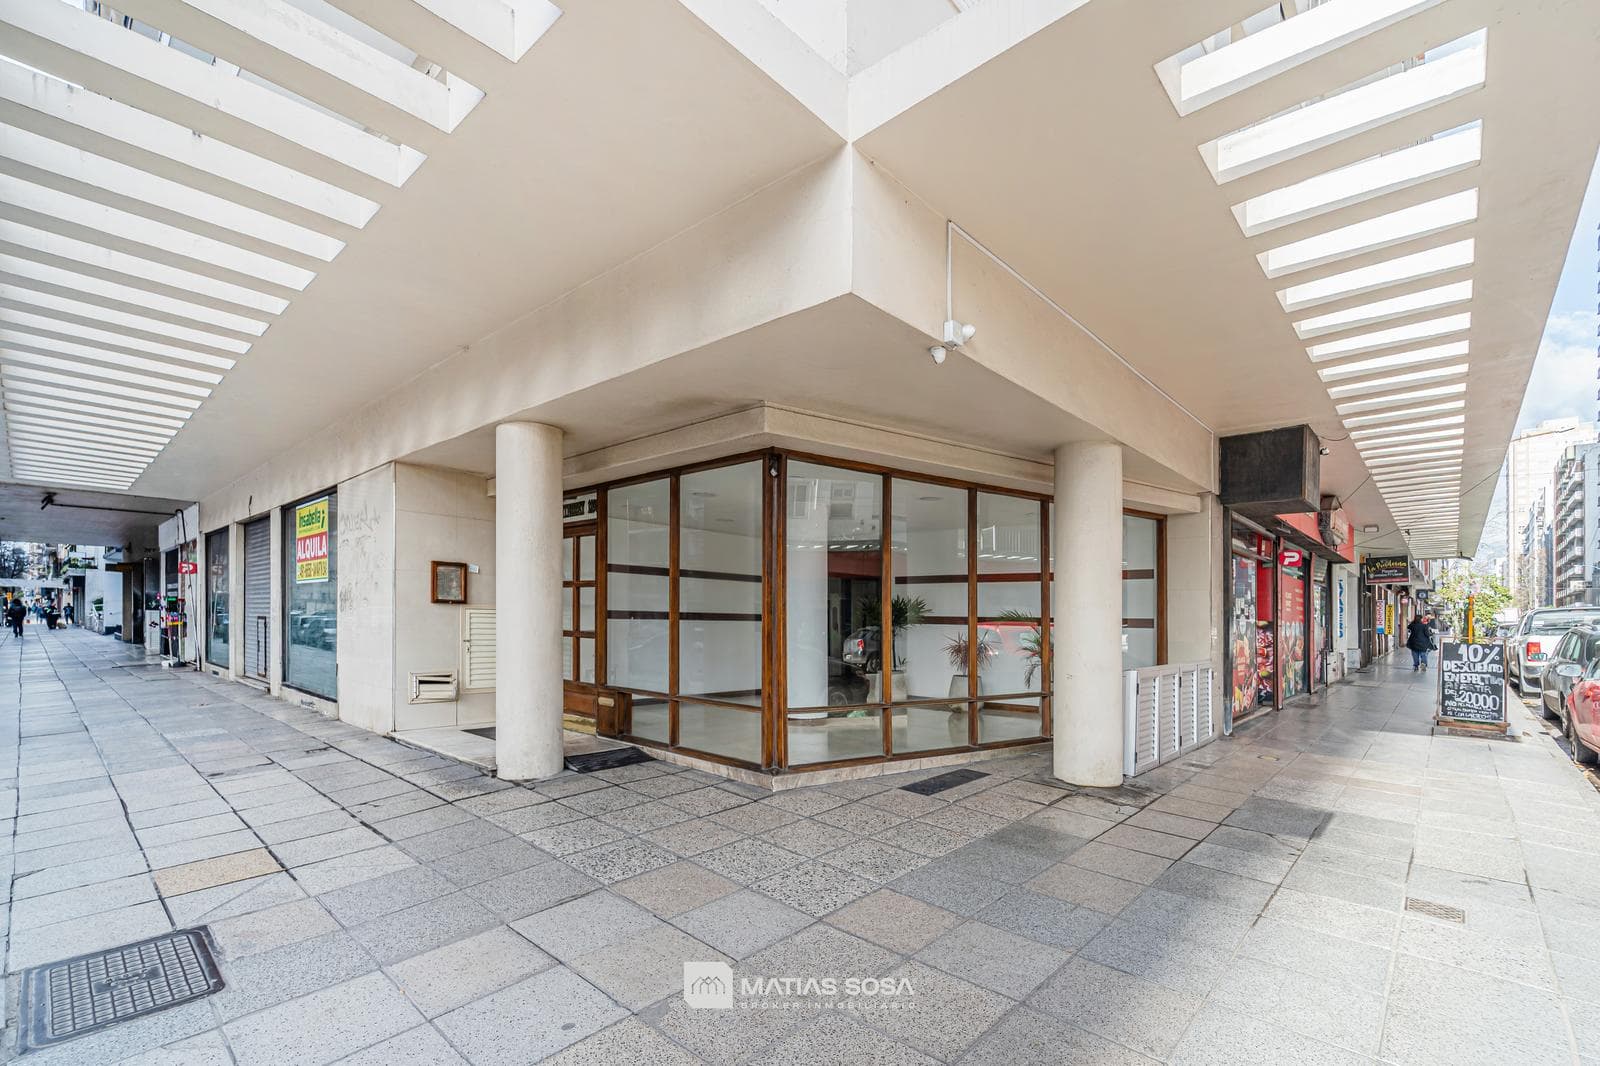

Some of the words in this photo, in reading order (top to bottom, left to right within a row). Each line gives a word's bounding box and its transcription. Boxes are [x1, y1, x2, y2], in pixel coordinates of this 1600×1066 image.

[297, 534, 327, 560] ALQUILA
[1458, 643, 1500, 664] 10%
[1443, 660, 1504, 673] DESCUENTO
